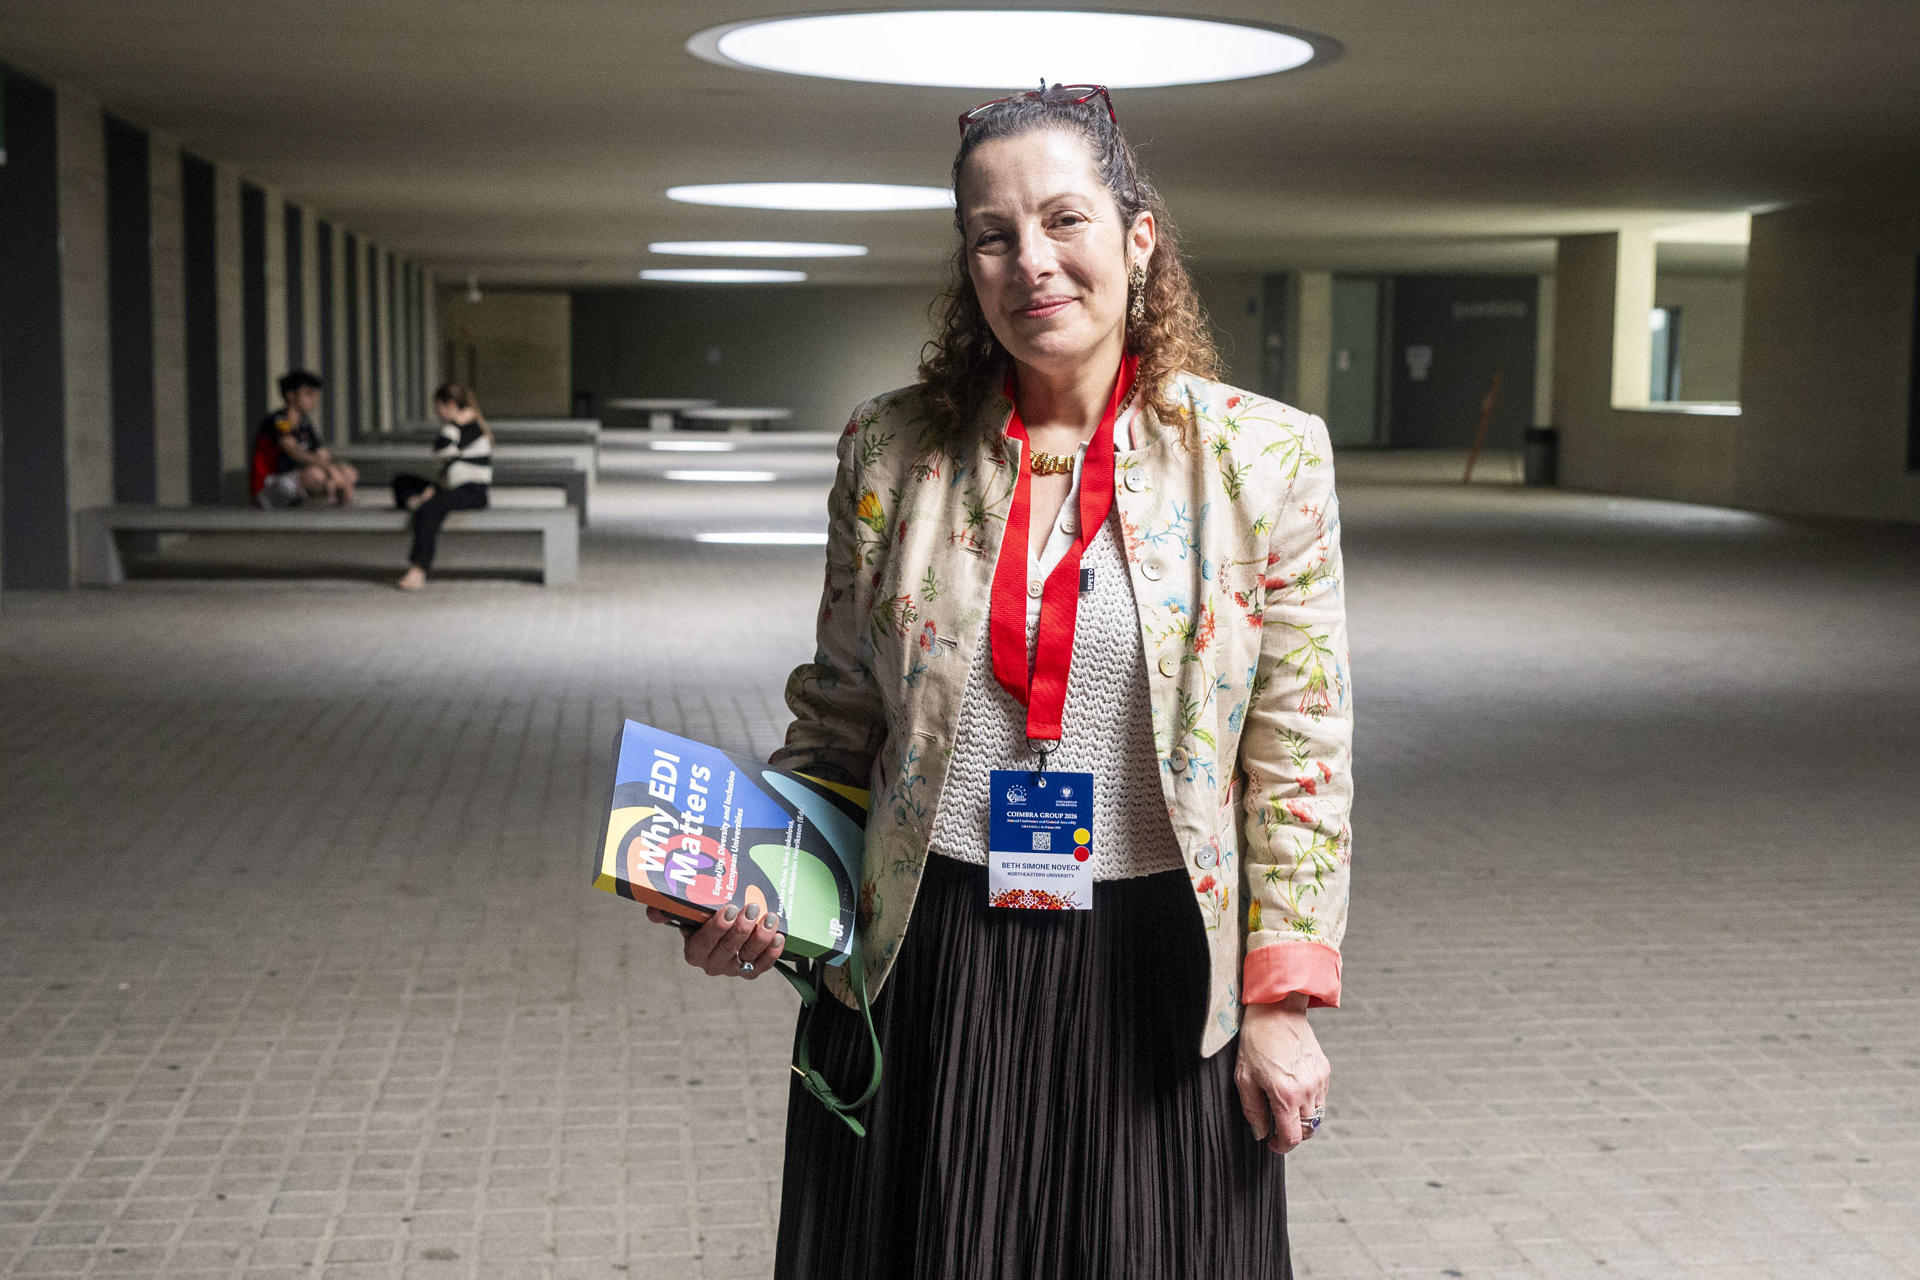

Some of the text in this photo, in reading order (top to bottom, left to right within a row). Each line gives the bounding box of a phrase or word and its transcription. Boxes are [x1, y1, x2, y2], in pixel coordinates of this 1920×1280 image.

[724, 770, 736, 806] Inclusion
[637, 749, 680, 872] Why EDI
[669, 763, 711, 886] Matters
[723, 805, 731, 821] and
[731, 807, 744, 853] Universities
[717, 820, 730, 856] Diversity
[726, 853, 739, 893] European
